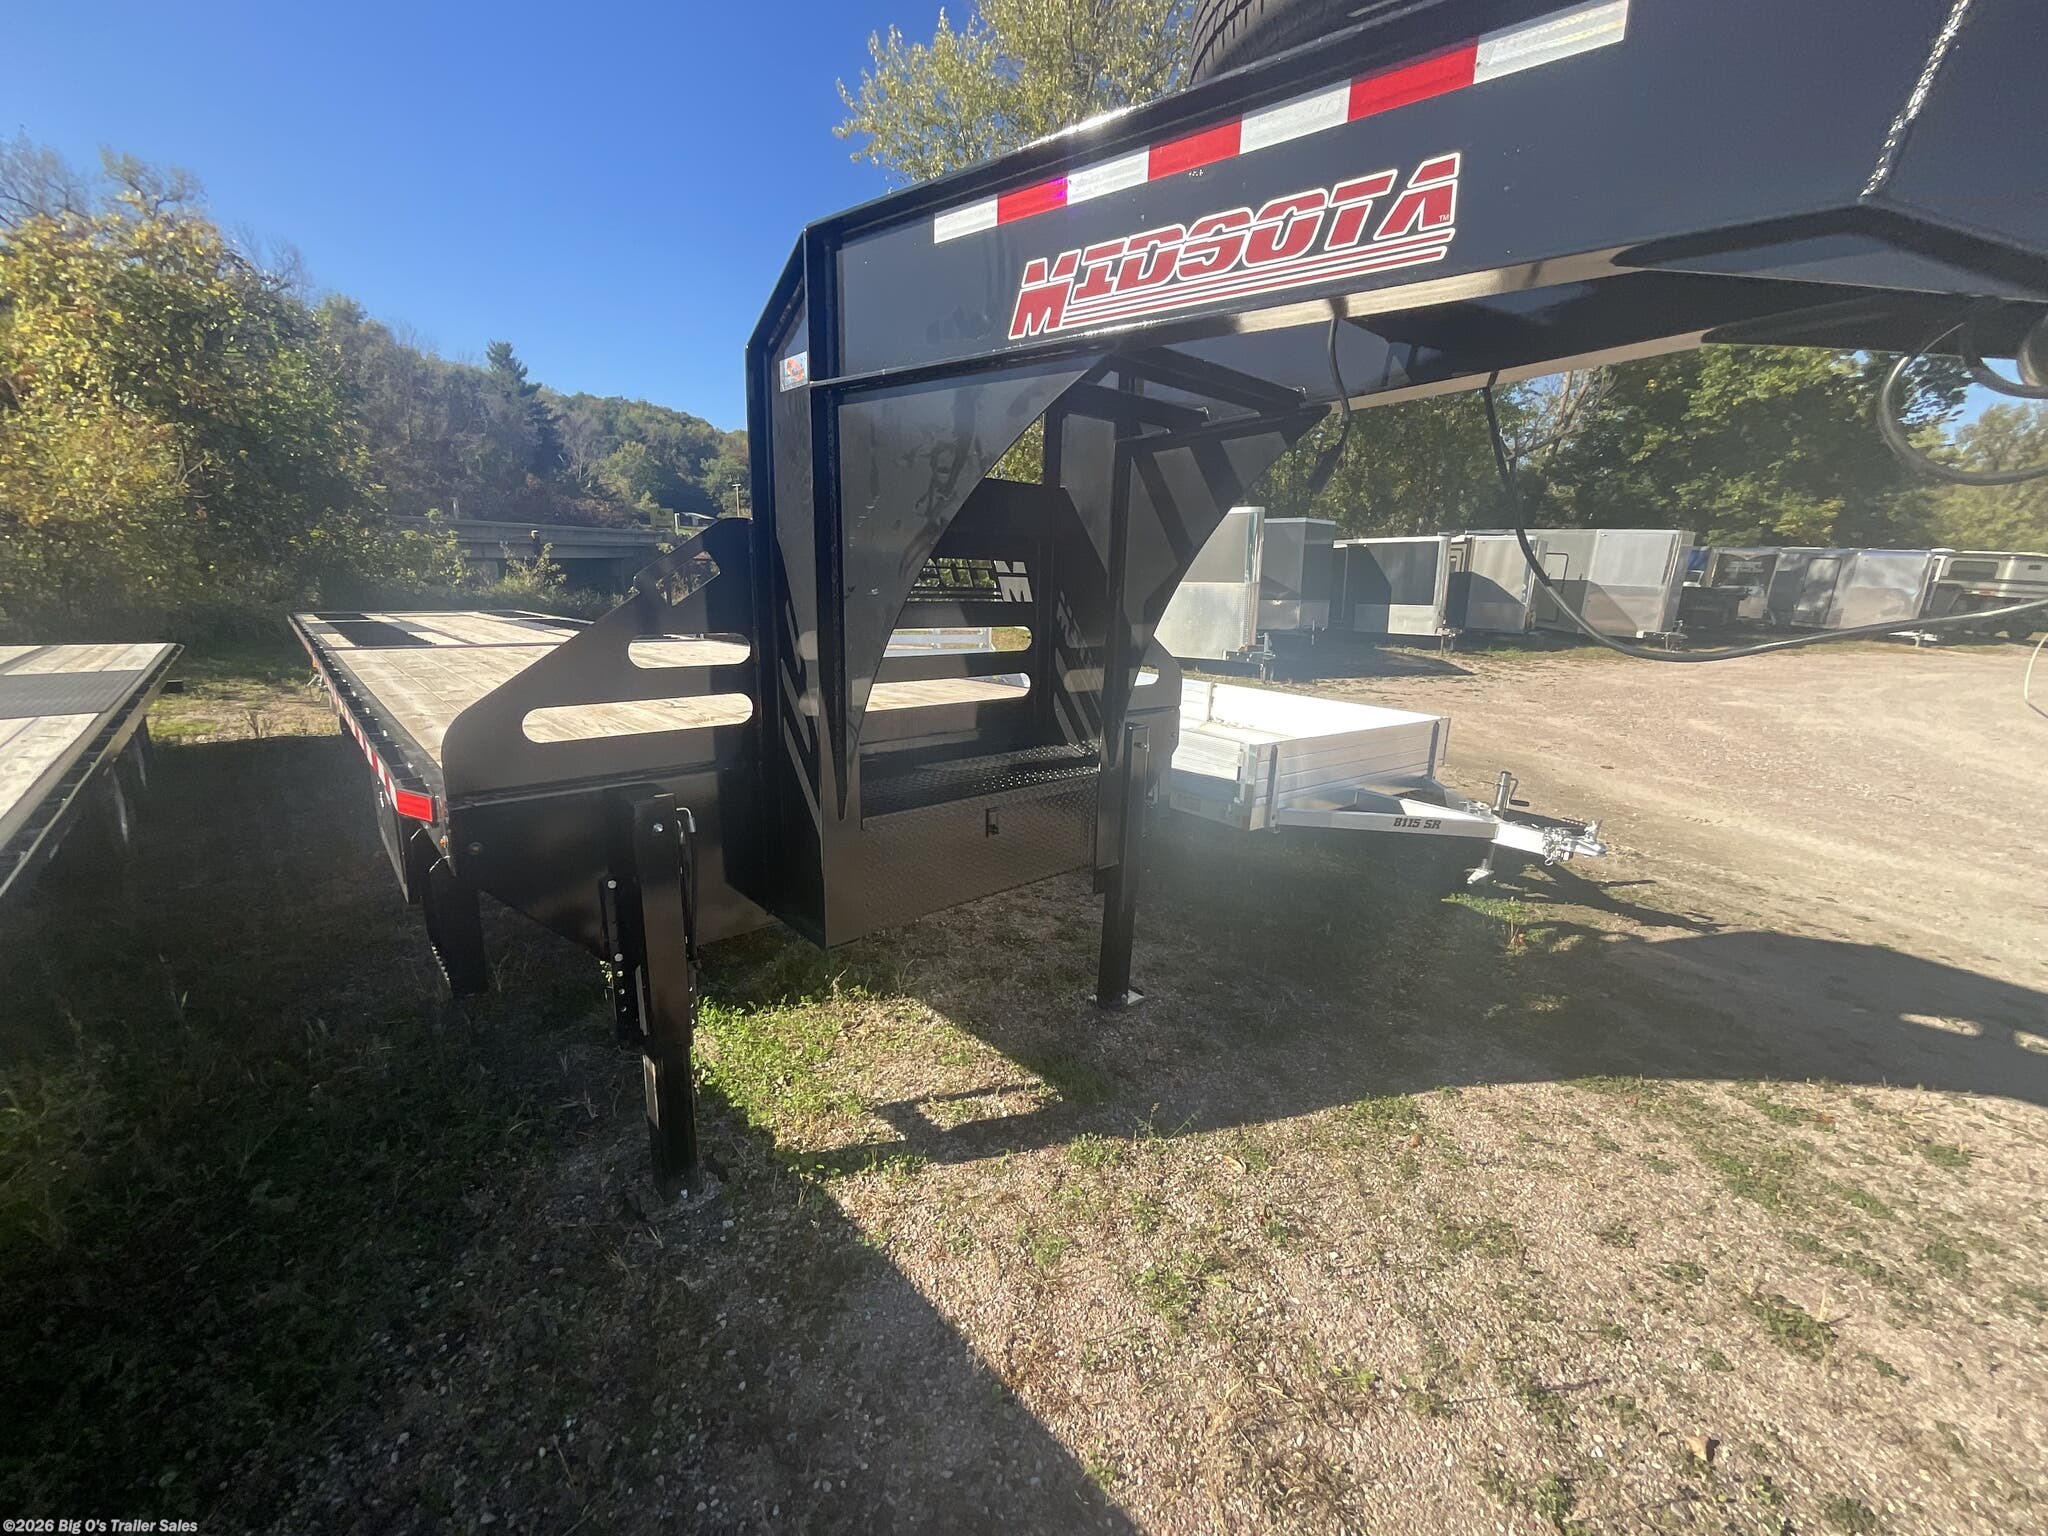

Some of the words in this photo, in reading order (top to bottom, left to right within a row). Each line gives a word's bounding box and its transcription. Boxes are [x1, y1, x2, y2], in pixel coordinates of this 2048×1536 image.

[1008, 151, 1460, 340] MIDSOTA
[1393, 817, 1421, 828] 8115
[1423, 819, 1442, 829] SR
